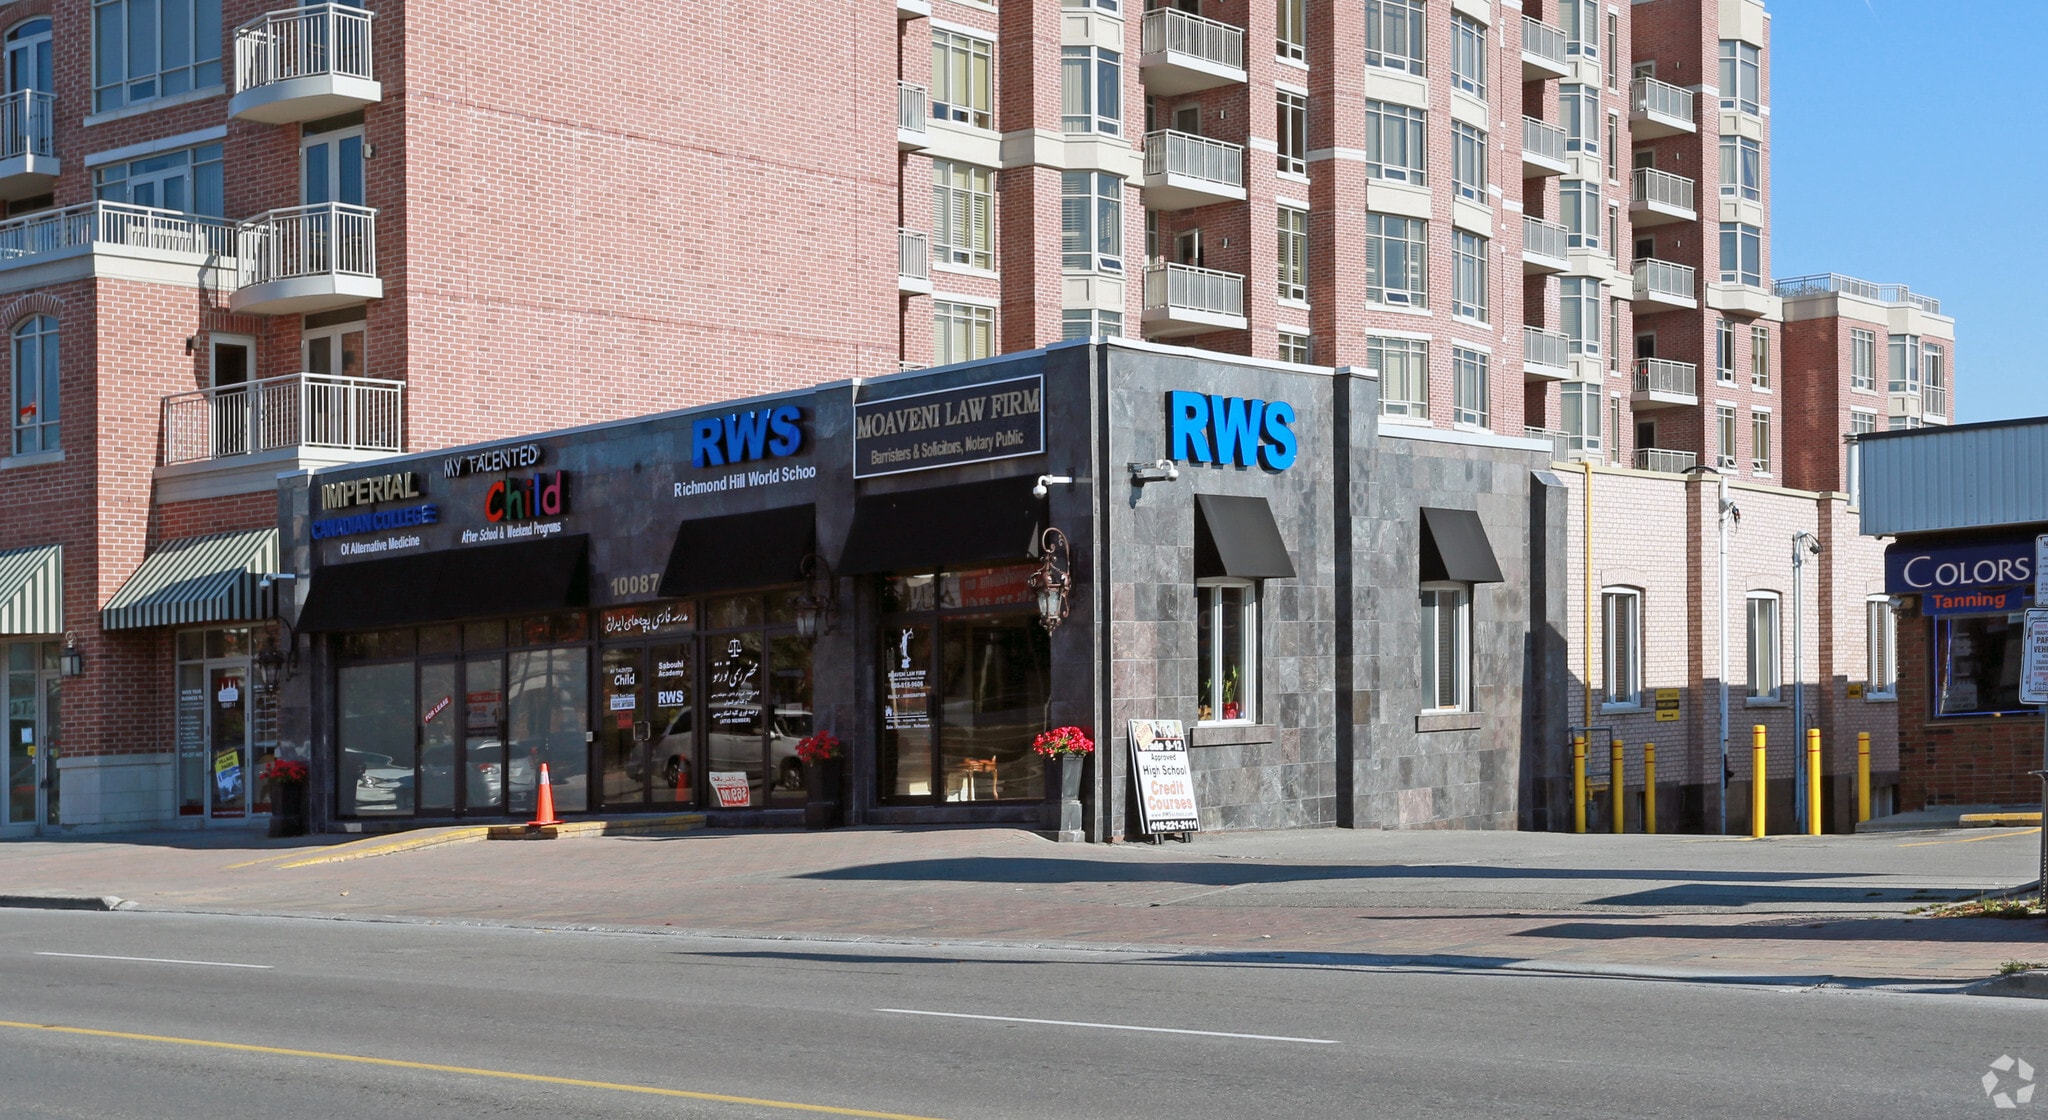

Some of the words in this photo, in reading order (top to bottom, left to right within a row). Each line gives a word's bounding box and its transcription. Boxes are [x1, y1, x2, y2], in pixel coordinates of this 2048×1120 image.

[856, 404, 940, 439] MOAVENI
[945, 397, 987, 427] LAW
[991, 388, 1041, 419] FIRM
[692, 405, 801, 468] RWS
[1166, 390, 1297, 470] RWS
[871, 448, 911, 465] Barristers
[913, 443, 920, 459] &
[922, 440, 964, 459] Solicitors,
[966, 435, 994, 453] Notary
[996, 430, 1024, 447] Public
[444, 457, 462, 478] MY
[468, 444, 540, 473] TALENTED
[322, 471, 420, 511] IMPERIAL
[674, 474, 727, 497] Richmond
[729, 473, 746, 490] Hill
[748, 468, 779, 487] World
[781, 465, 816, 482] Schoo
[484, 470, 562, 523] Child
[311, 512, 373, 540] CANADIAN
[373, 503, 438, 530] COLLEGE
[462, 529, 479, 543] After
[480, 526, 499, 541] School
[507, 522, 533, 538] Weekend
[534, 521, 562, 537] Programs
[341, 543, 350, 556] Of
[350, 539, 387, 555] Alternative
[388, 535, 420, 551] Medicine
[1903, 556, 2031, 588] COLORS
[611, 573, 660, 596] 10087
[1932, 593, 2006, 609] Tanning
[652, 606, 671, 630] فارسی
[658, 660, 684, 670] Sabouhi
[658, 670, 684, 678] Academy
[614, 673, 635, 686] Child
[658, 690, 684, 704] RWS
[425, 709, 435, 721] FOR
[435, 697, 450, 714] LEASE
[1151, 753, 1177, 761] Approved
[1165, 740, 1183, 751] 9-12
[1143, 765, 1161, 777] High
[1162, 765, 1187, 776] School
[1151, 780, 1185, 795] Credit
[1148, 796, 1194, 810] Courses
